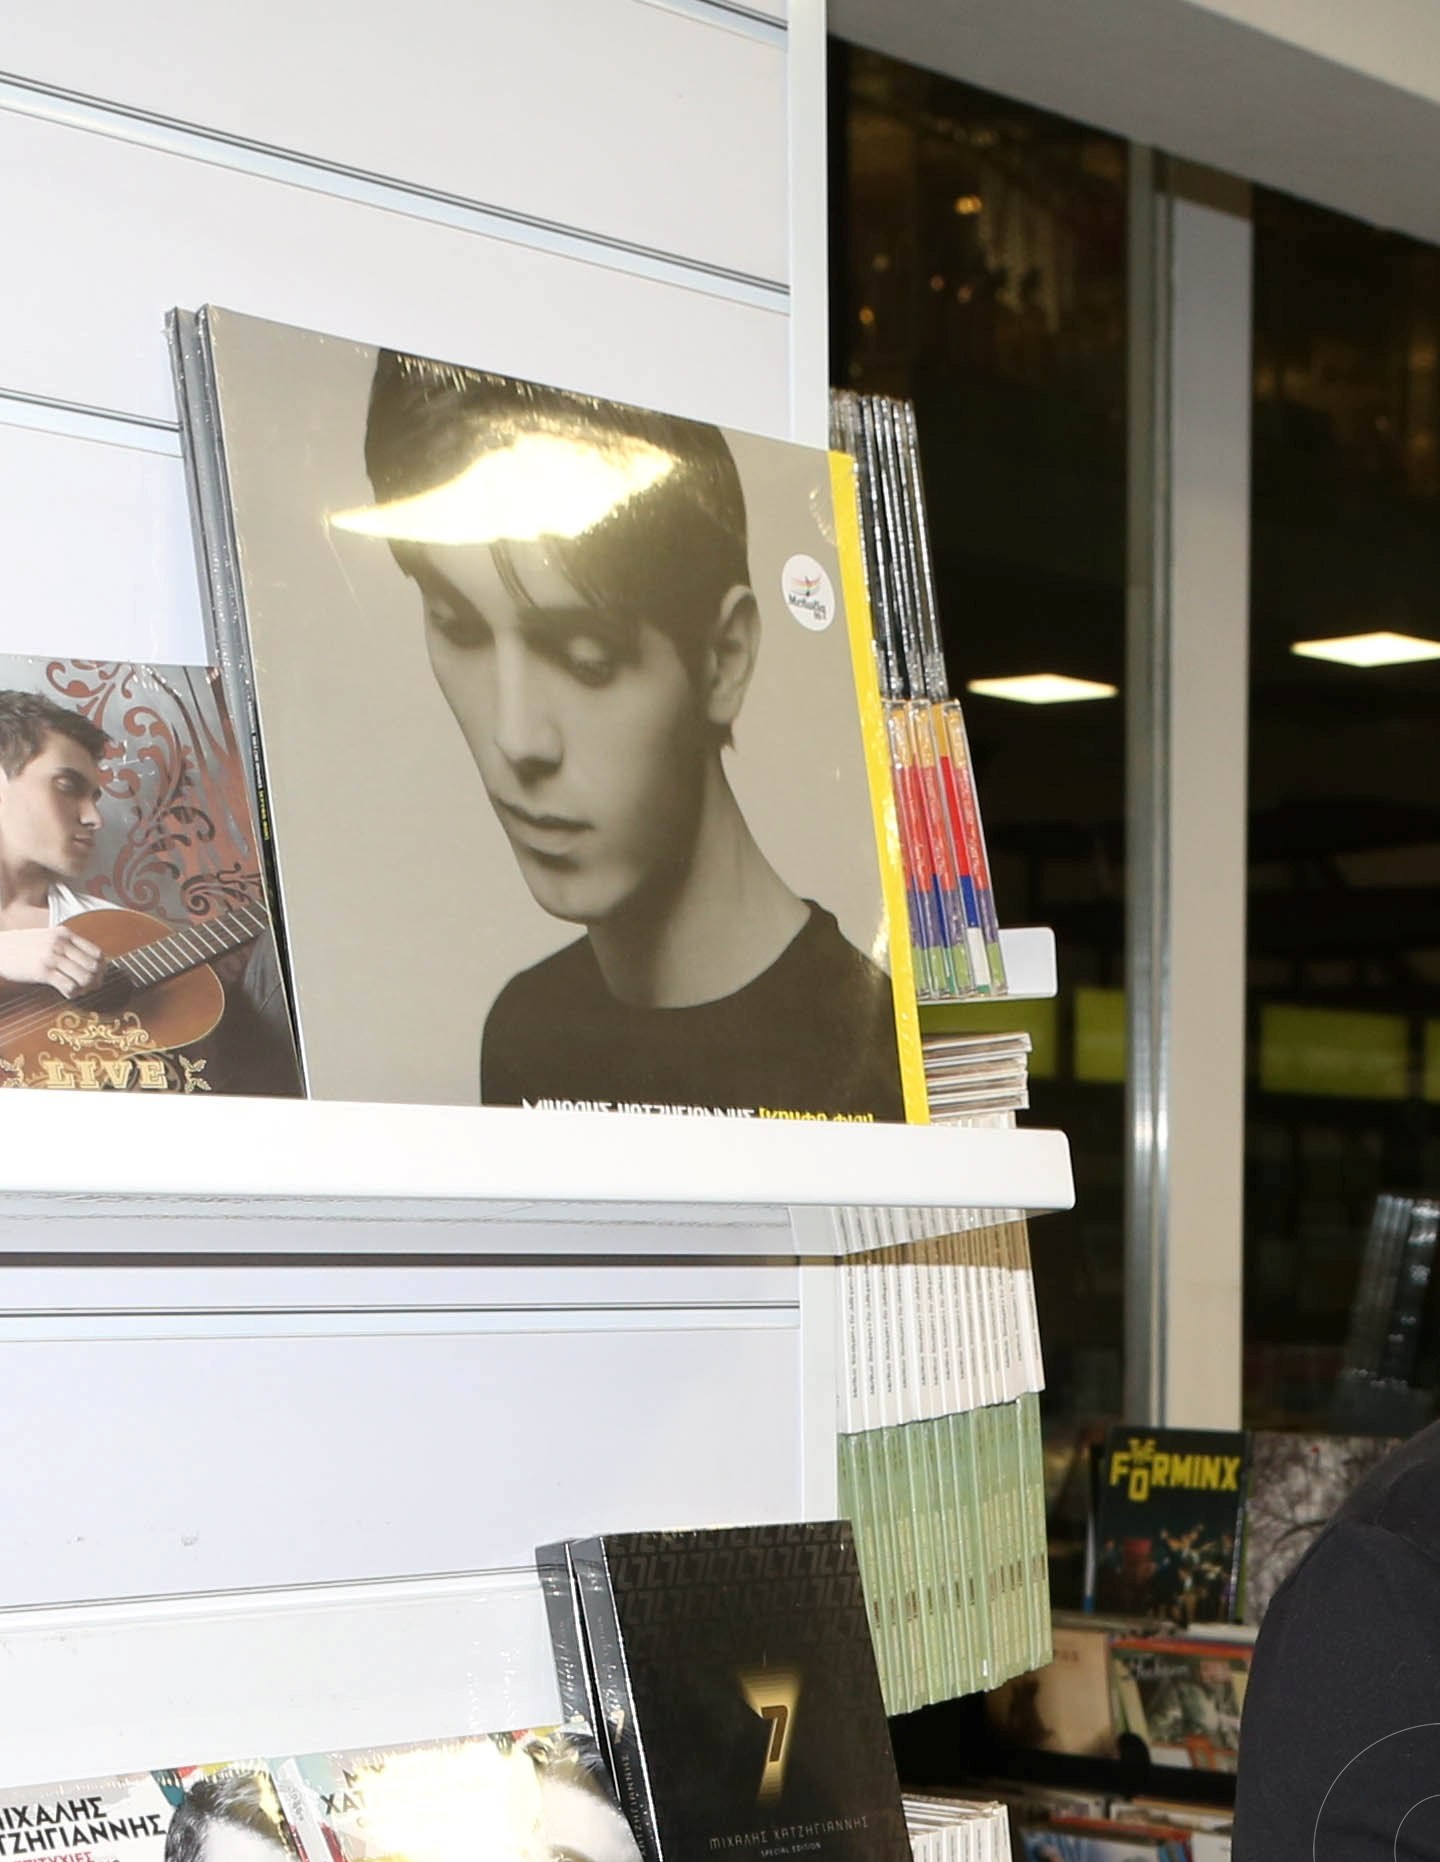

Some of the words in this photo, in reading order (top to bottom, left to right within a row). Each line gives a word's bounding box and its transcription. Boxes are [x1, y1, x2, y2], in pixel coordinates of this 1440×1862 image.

[42, 1060, 168, 1089] LIVE
[1110, 1450, 1240, 1502] FORMINX
[761, 1704, 789, 1764] 7
[709, 1830, 768, 1850] ΜΙΧΑΛΗΣ
[773, 1815, 869, 1841] ΧΑΤΖΗΓΙΑΝΝΗΣ
[760, 1847, 789, 1858] SPECIAL
[792, 1841, 822, 1853] EDITION
